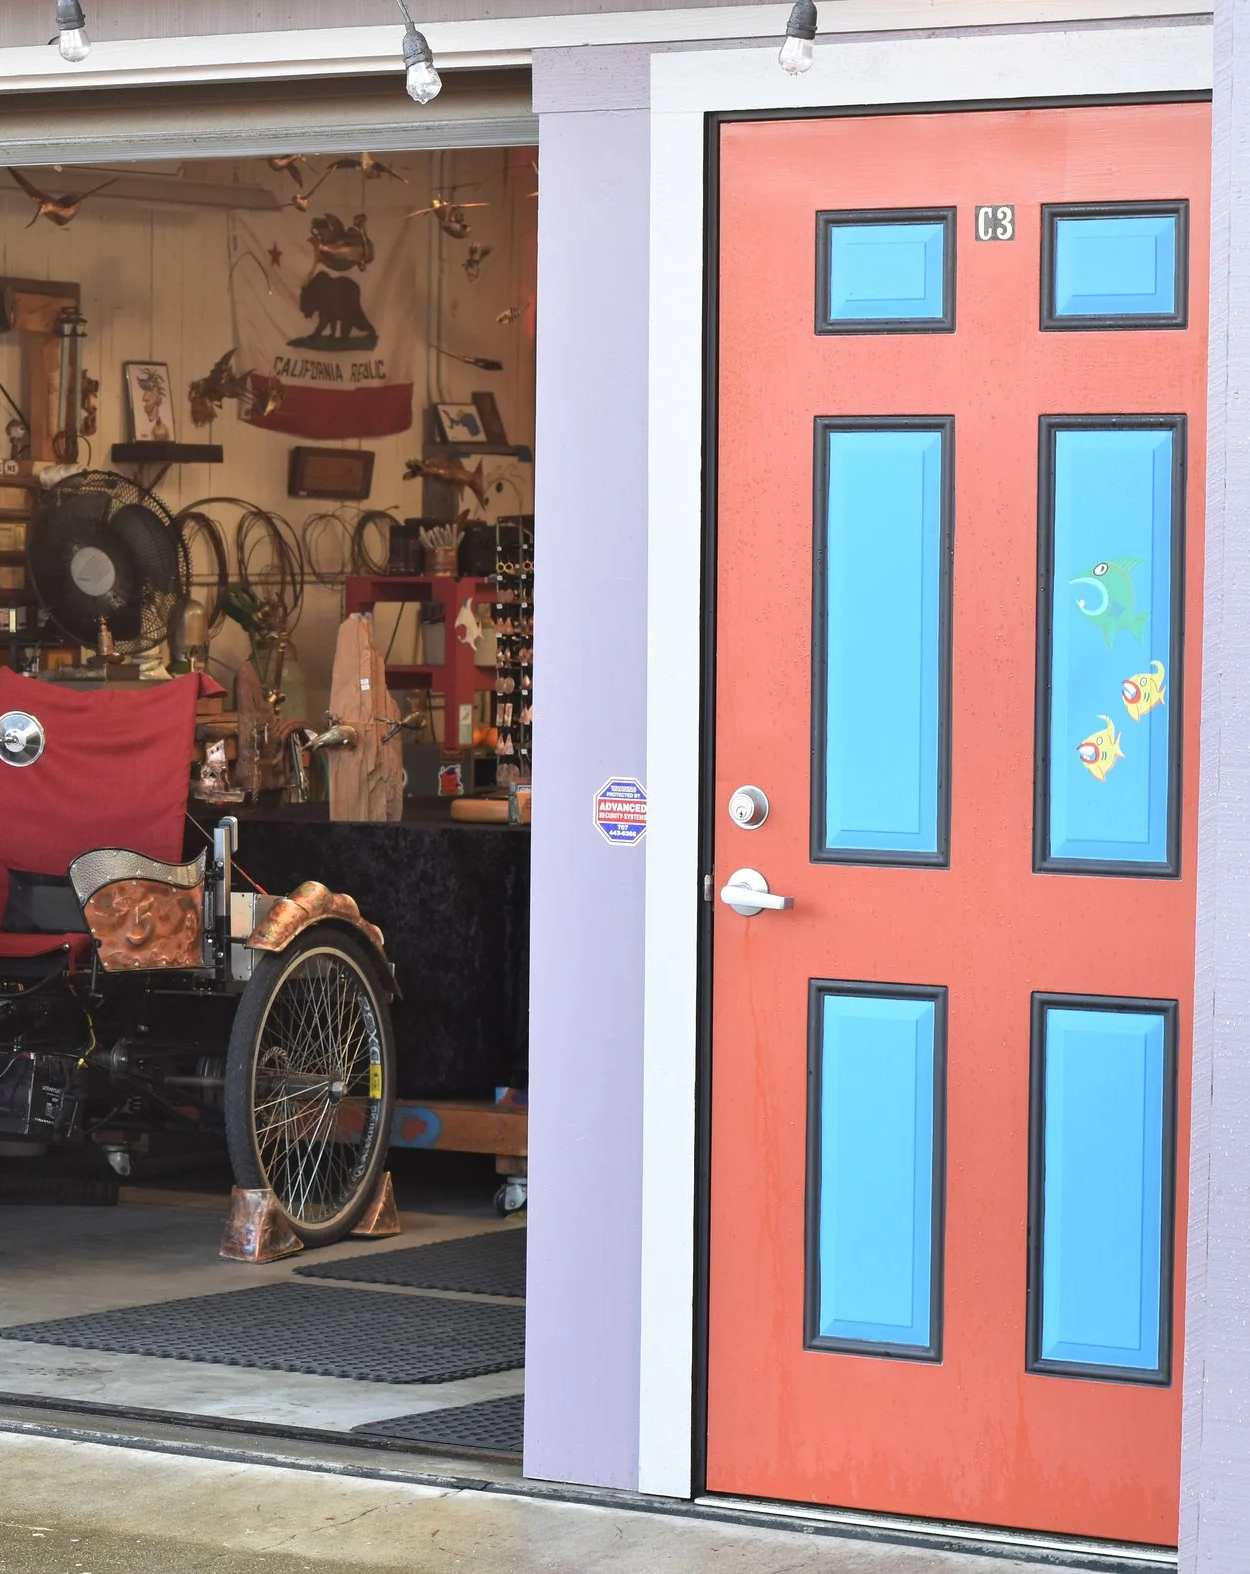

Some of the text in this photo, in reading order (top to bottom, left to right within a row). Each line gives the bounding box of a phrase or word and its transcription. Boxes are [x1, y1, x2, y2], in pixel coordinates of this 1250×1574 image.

[978, 207, 1013, 240] C3
[273, 356, 343, 382] CALIFORNIA
[599, 802, 646, 813] ADVANCED
